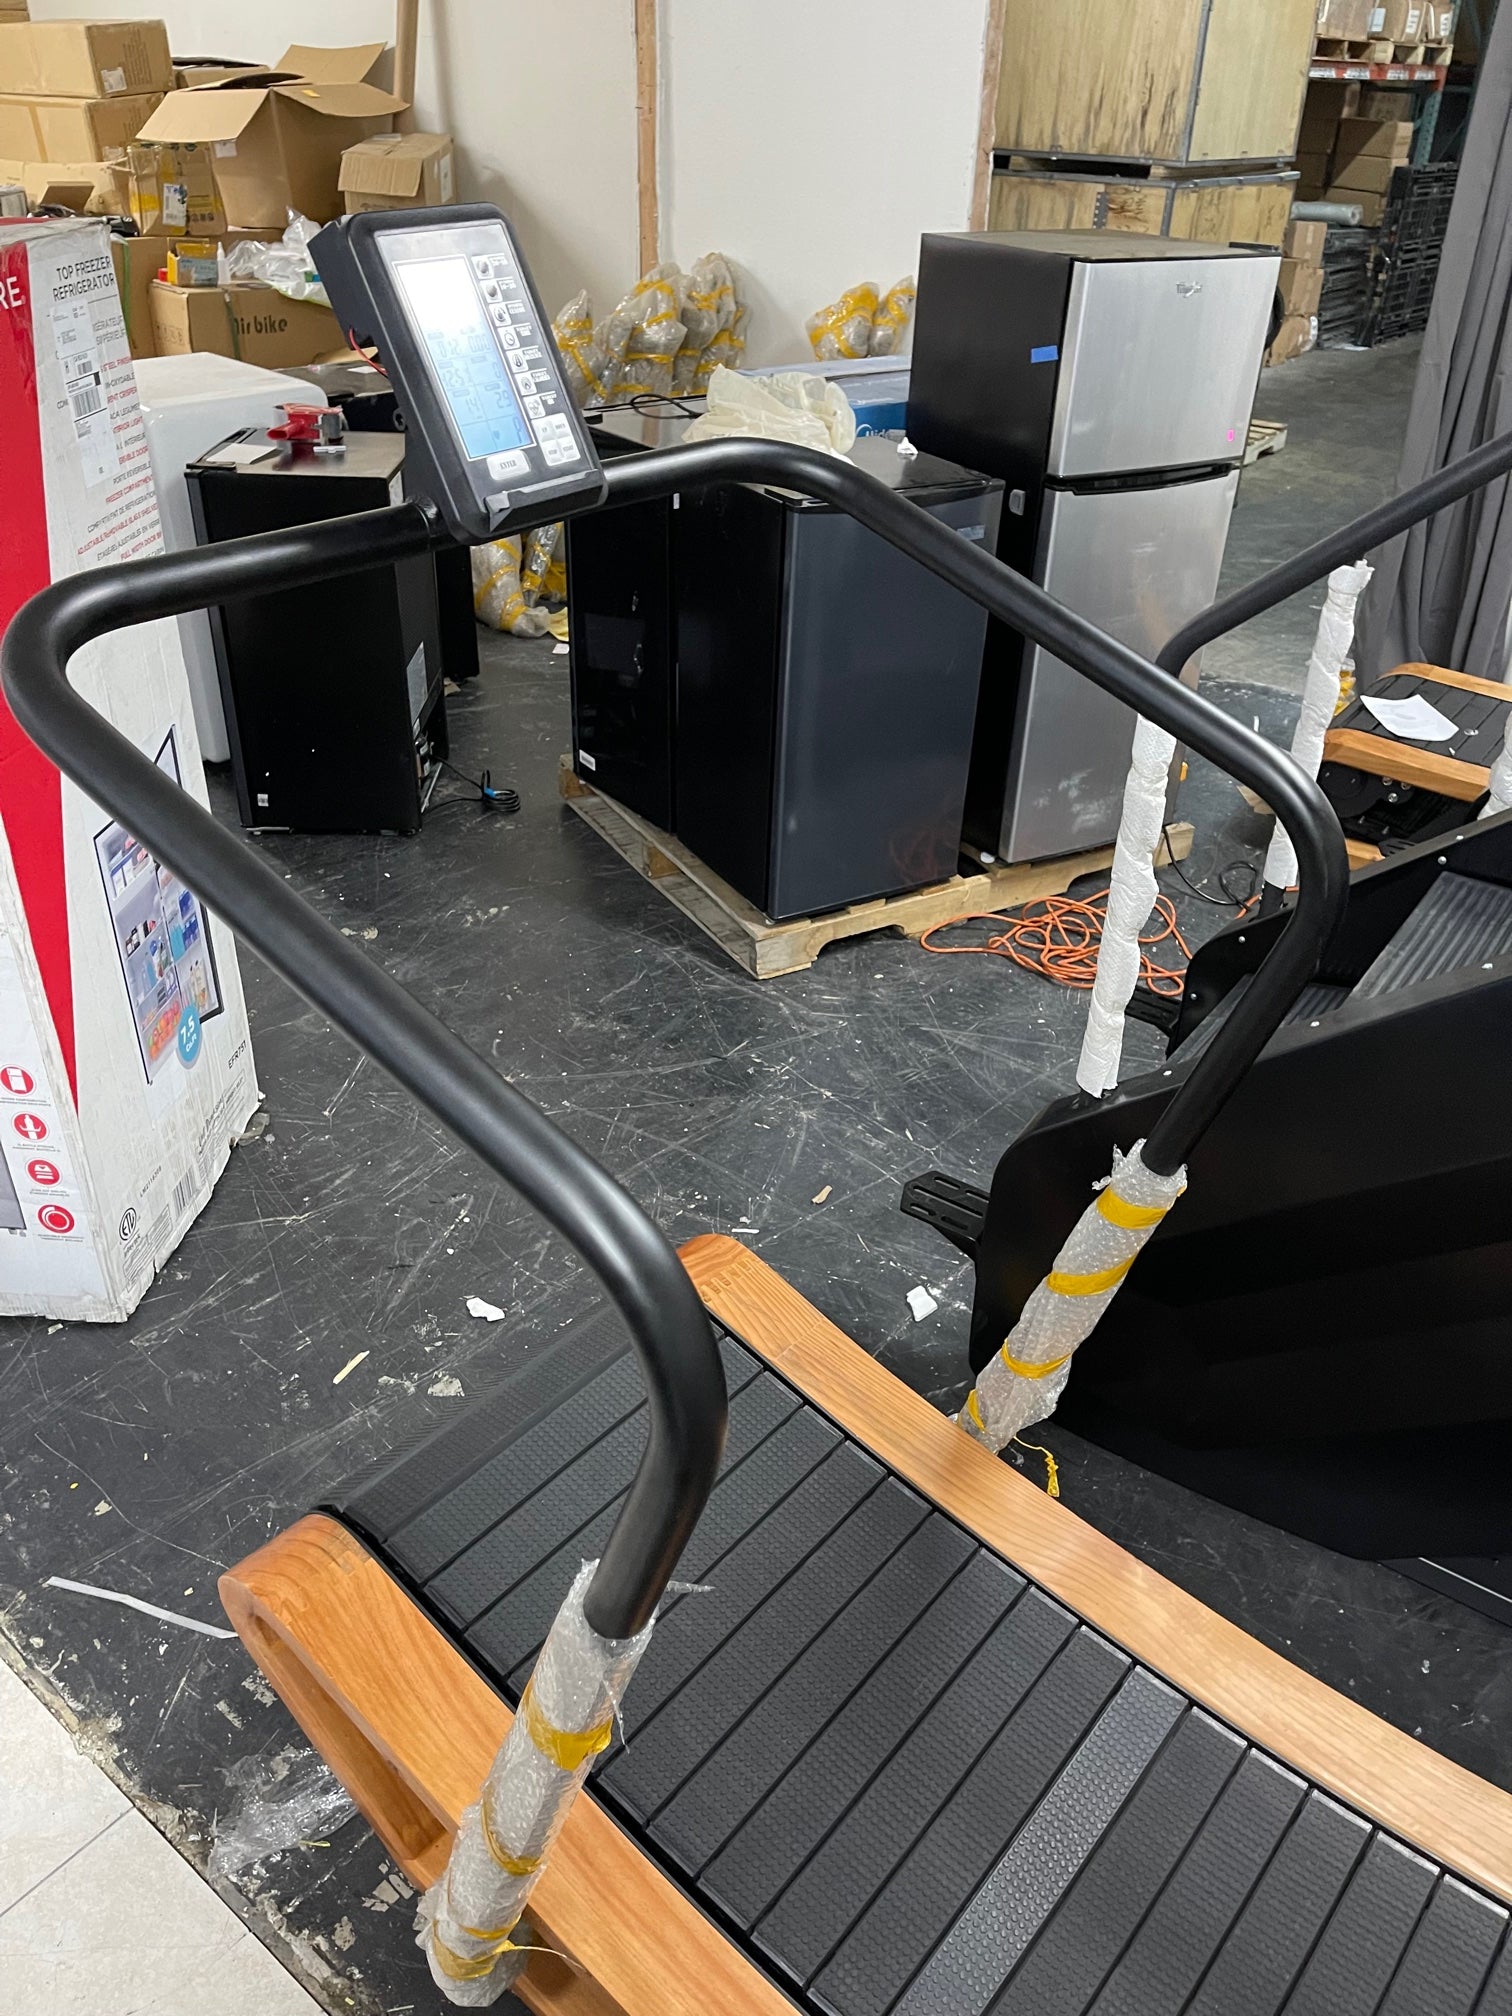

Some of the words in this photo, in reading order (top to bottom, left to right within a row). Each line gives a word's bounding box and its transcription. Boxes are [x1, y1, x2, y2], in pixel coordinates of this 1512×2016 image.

[56, 265, 74, 280] TOP
[75, 256, 113, 277] FREEZER
[53, 273, 115, 302] REFRIGERATOR
[500, 460, 517, 470] ENTER
[181, 1016, 195, 1043] 7.5
